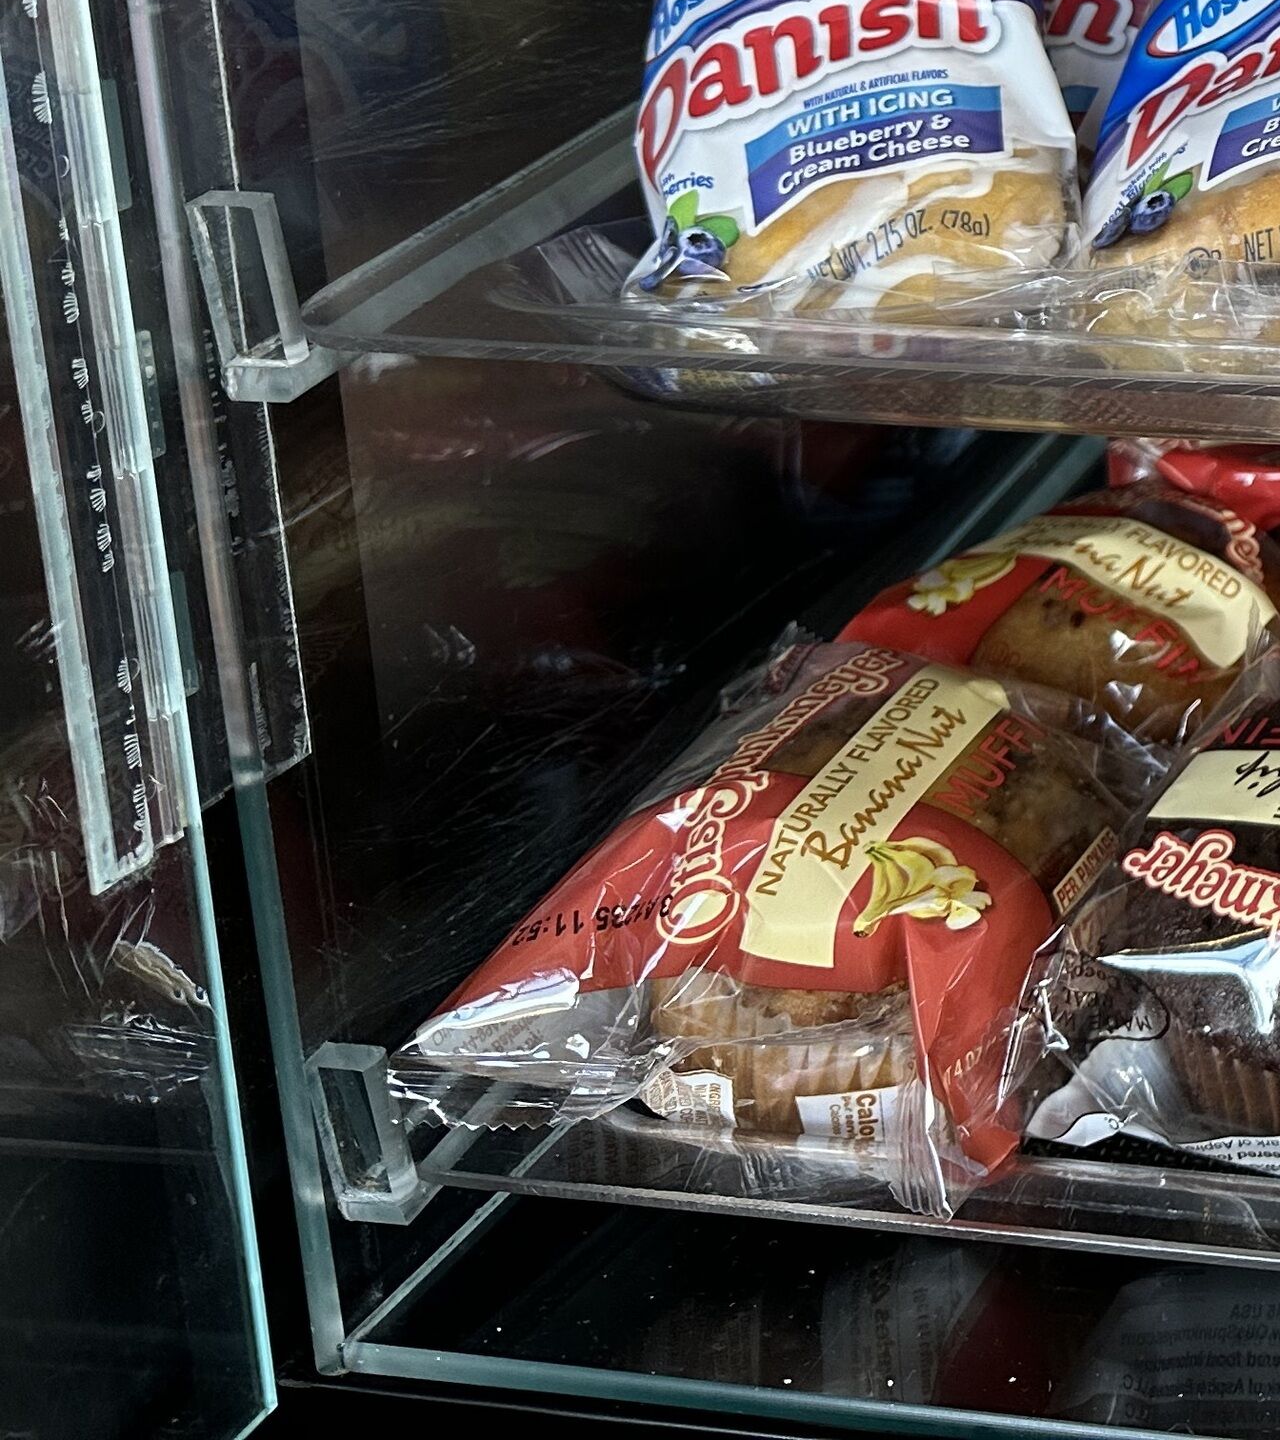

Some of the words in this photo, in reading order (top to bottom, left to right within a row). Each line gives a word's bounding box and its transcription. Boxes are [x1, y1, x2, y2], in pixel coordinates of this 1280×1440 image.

[829, 82, 859, 104] NATURAL
[868, 73, 911, 92] ARTIFICIAL
[913, 67, 949, 85] FLAVORS
[787, 105, 861, 140] WITH
[869, 89, 954, 116] ICING
[789, 118, 925, 166] Blueberry
[930, 113, 953, 133] &
[777, 153, 861, 196] Cream
[866, 131, 971, 163] Cheese
[872, 224, 904, 263] 2.75
[905, 212, 934, 245] OZ.
[940, 206, 991, 241] (78g)
[1243, 228, 1276, 263] NET
[1117, 558, 1190, 610] Nut
[1125, 525, 1243, 600] FLAVORED
[757, 759, 856, 898] NATURALLY
[852, 675, 941, 764] FLAVORED
[800, 753, 924, 871] Banana
[912, 705, 967, 767] Nut
[934, 712, 1047, 813] MUFFI
[1056, 879, 1080, 913] PER
[511, 909, 587, 947] 11:52
